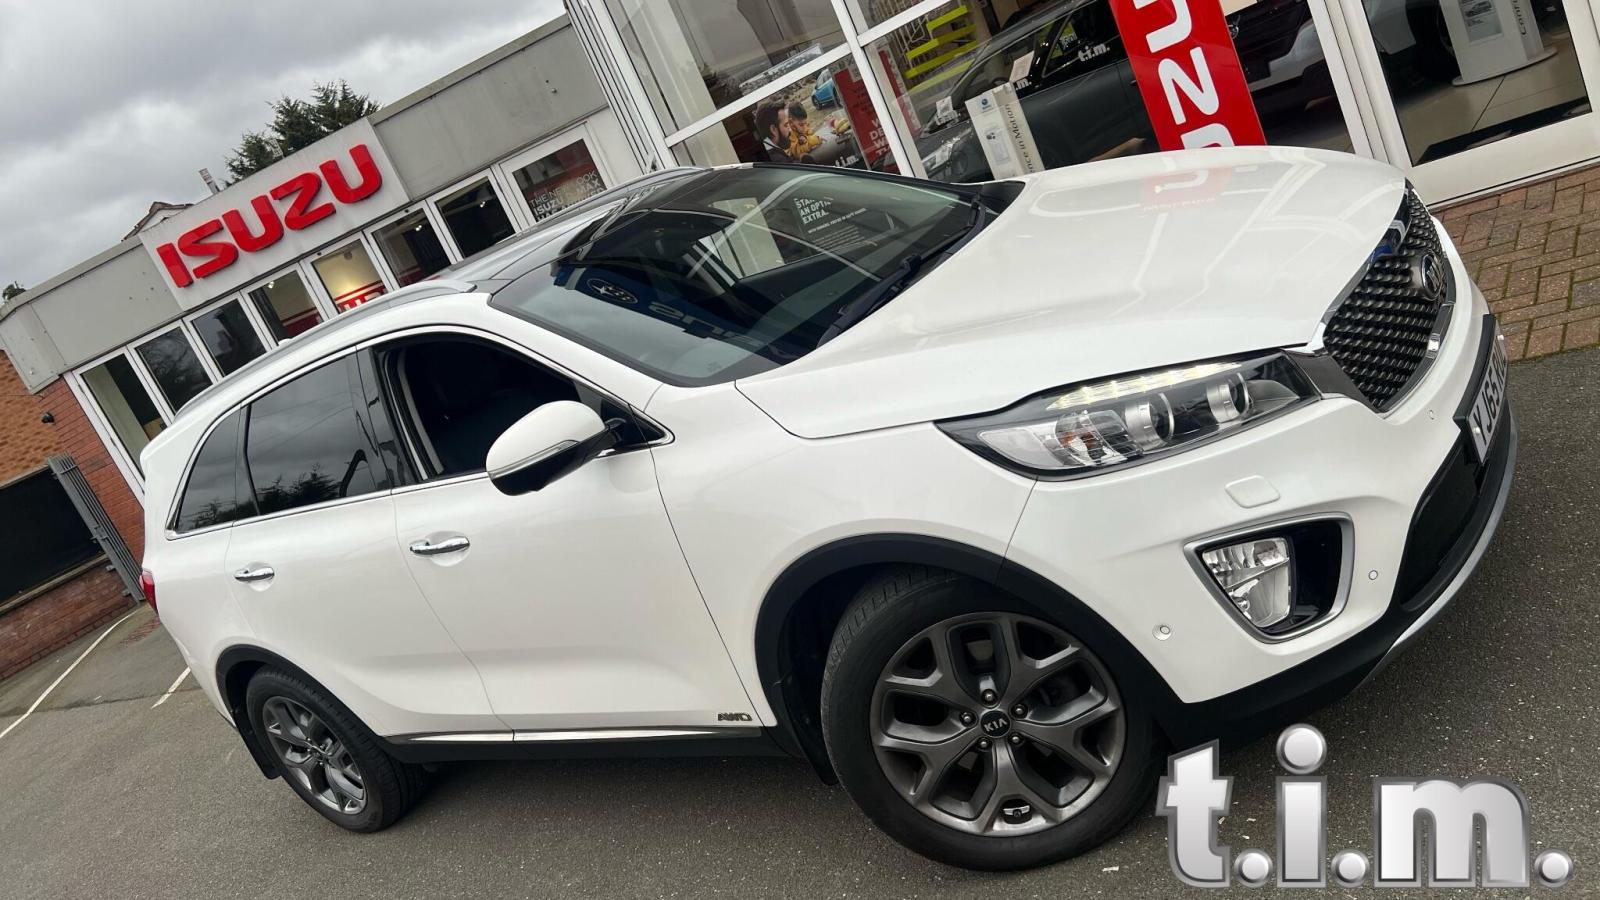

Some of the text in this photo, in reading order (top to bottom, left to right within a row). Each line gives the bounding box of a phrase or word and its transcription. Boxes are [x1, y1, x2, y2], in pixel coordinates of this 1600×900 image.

[1078, 42, 1111, 62] t.i.m.
[1005, 104, 1022, 139] Motion
[529, 192, 548, 208] THE
[533, 196, 563, 216] ISUZU
[156, 144, 383, 288] ISUZU
[1473, 366, 1500, 446] YJ65
[983, 718, 1008, 732] KIA
